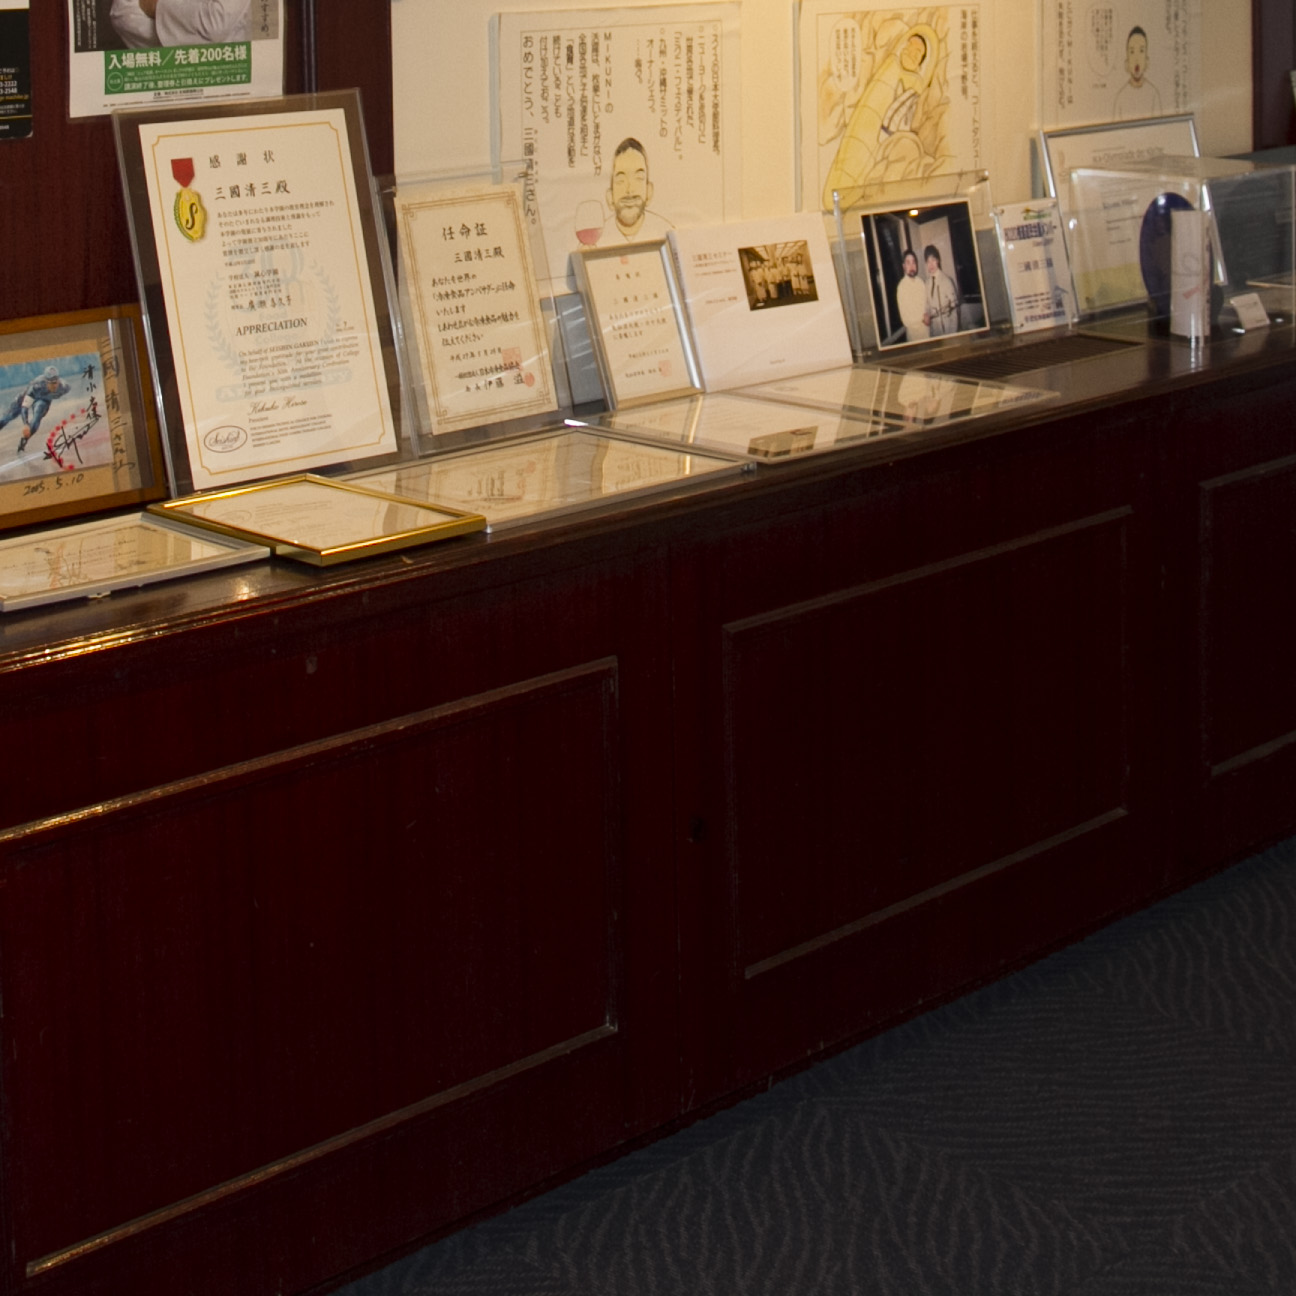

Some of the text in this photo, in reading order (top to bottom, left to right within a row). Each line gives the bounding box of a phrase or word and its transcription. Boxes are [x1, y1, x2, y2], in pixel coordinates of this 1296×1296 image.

[209, 149, 275, 169] 感謝状
[214, 179, 291, 201] 三國清三殿
[441, 222, 488, 241] 任命証
[454, 246, 505, 264] 三國清三殿
[235, 317, 309, 337] APPRECIATION
